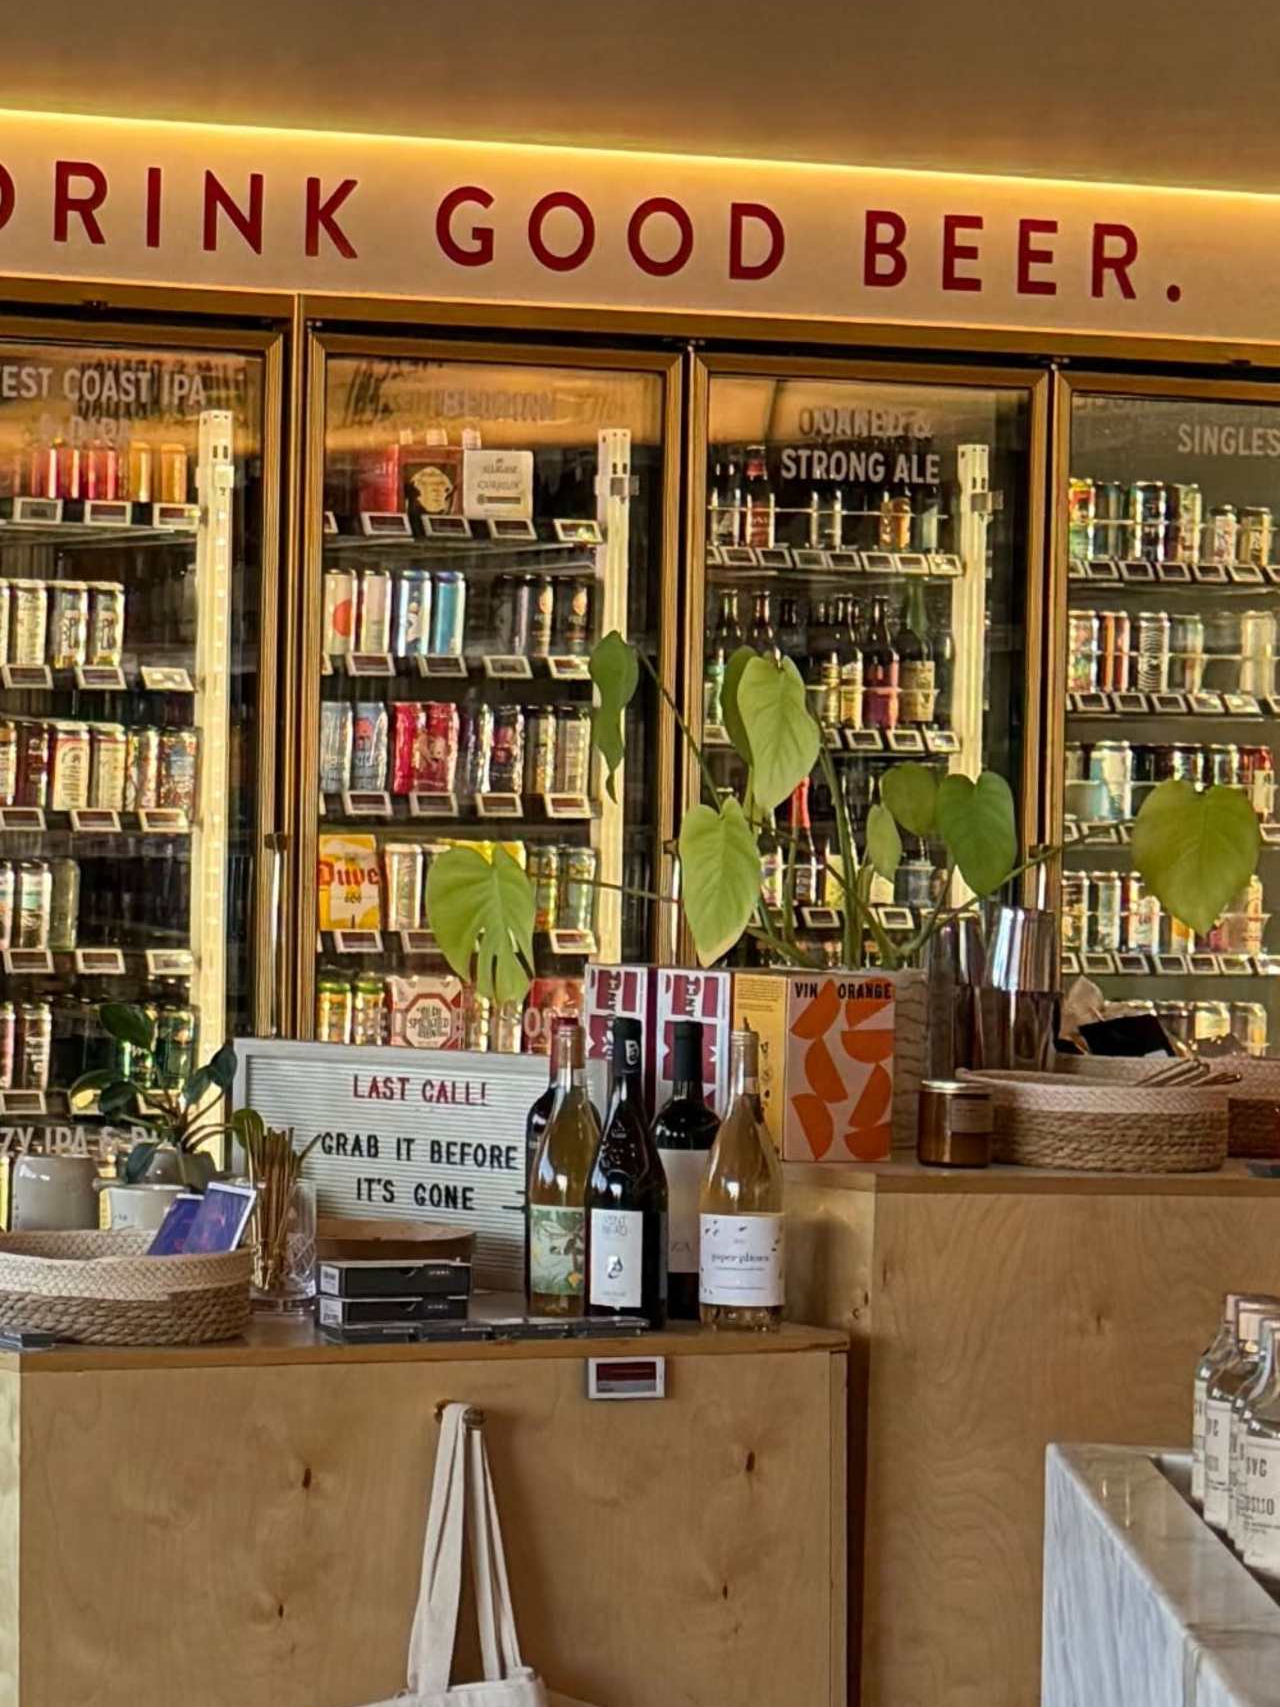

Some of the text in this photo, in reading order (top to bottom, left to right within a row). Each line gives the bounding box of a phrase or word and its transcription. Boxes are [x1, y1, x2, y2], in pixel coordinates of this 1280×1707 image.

[434, 184, 788, 282] GOOD
[861, 208, 1184, 304] BEER.
[63, 366, 153, 403] COAST
[161, 372, 208, 406] IPA
[1176, 423, 1280, 457] SINGLES
[780, 448, 941, 485] STRONG ALE
[794, 982, 819, 999] VIN
[837, 982, 893, 1000] ORANGE
[351, 1073, 489, 1109] LAST CALL!
[44, 1126, 90, 1156] IPA
[319, 1129, 520, 1171] GRAB IT BEFORE
[355, 1177, 476, 1213] IT'S GONE
